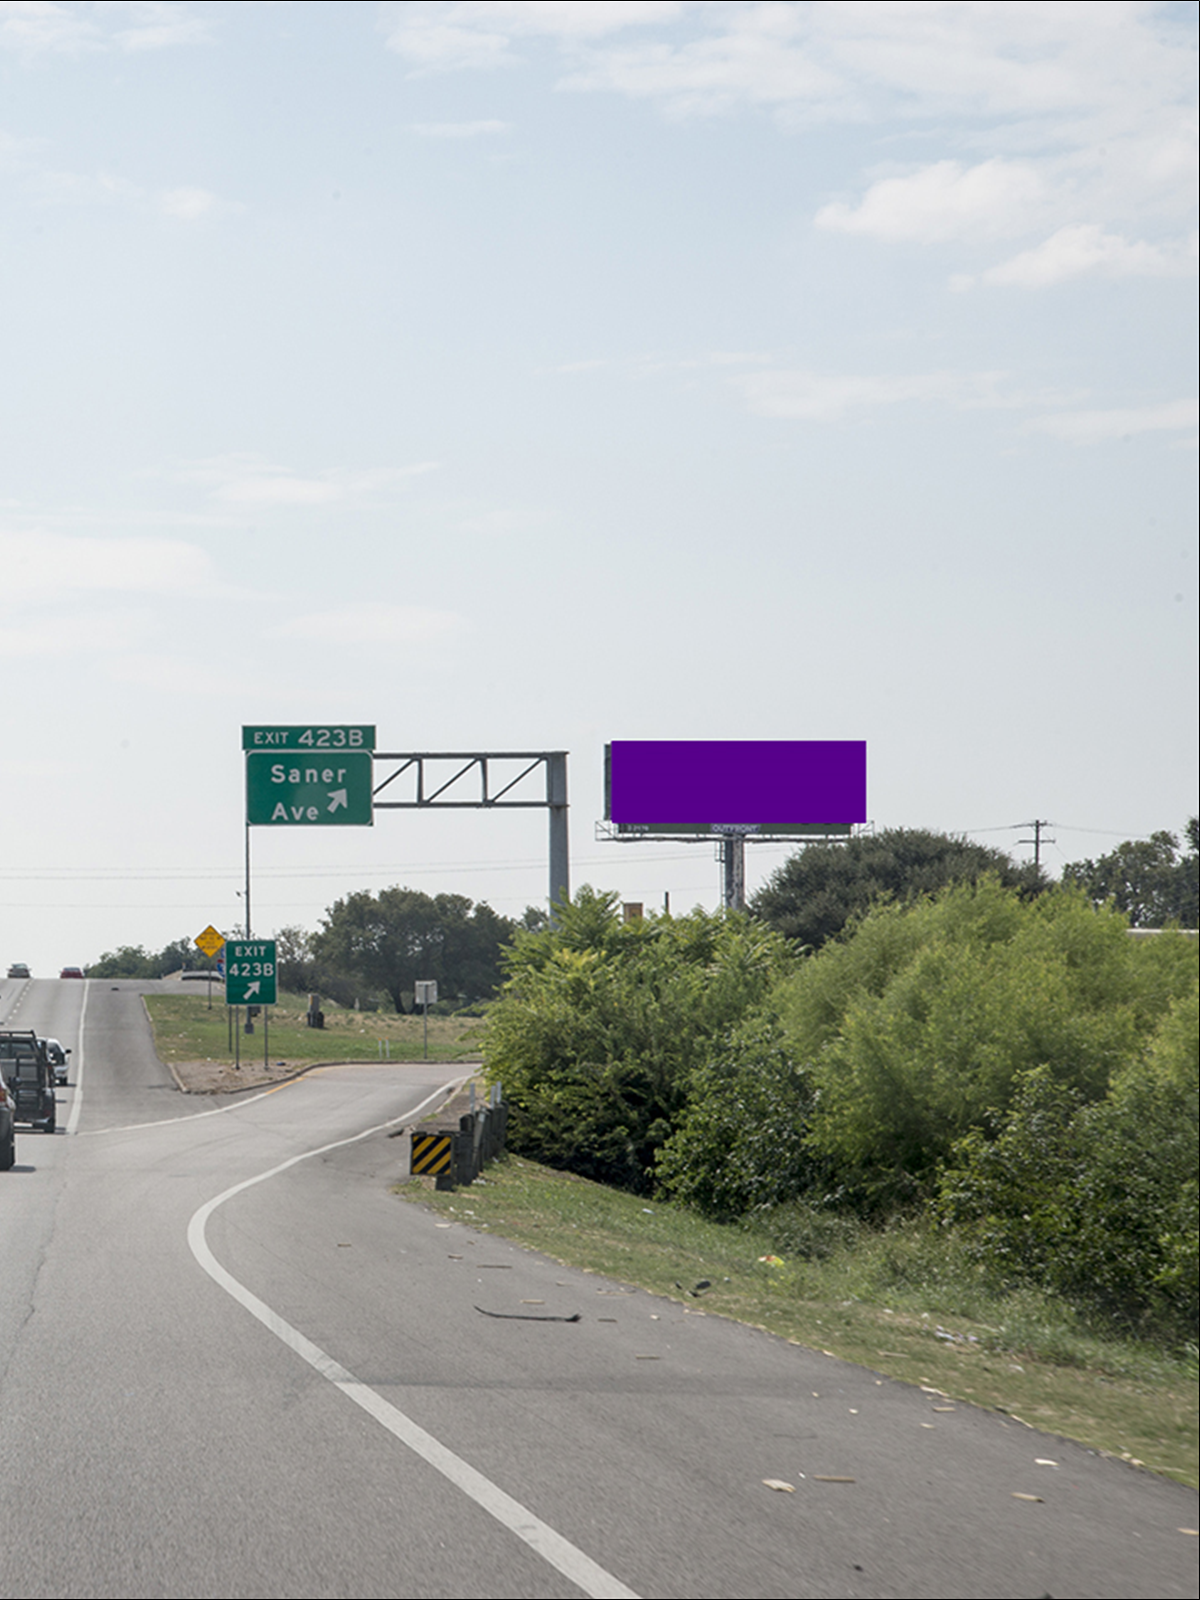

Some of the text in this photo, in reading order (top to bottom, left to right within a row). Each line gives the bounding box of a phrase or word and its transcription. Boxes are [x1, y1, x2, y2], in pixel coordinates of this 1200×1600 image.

[253, 729, 364, 747] EXIT 423B
[271, 764, 347, 783] Saner
[271, 802, 319, 821] Ave
[235, 946, 267, 957] EXIT
[229, 962, 275, 977] 423B
